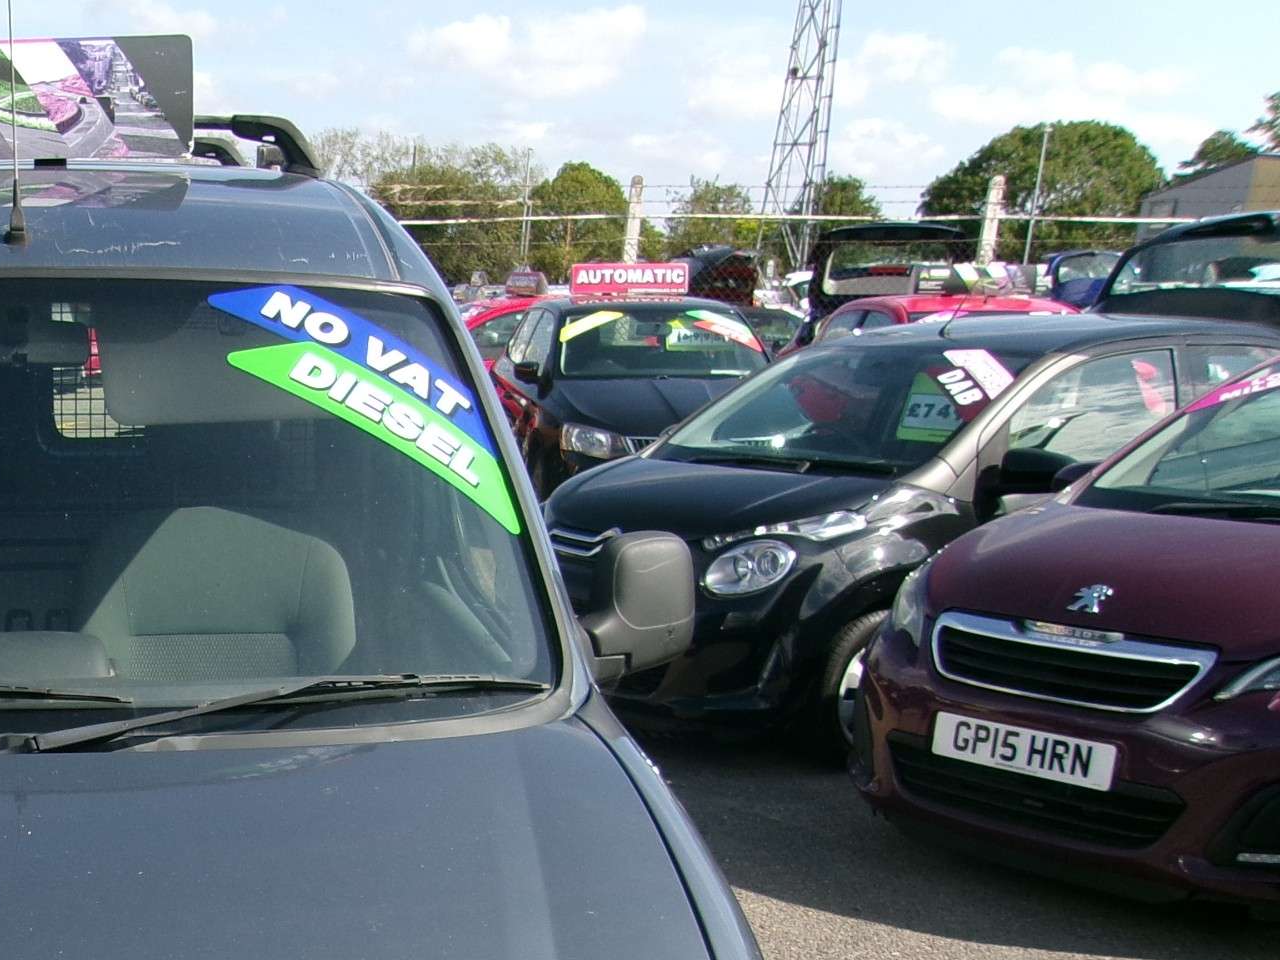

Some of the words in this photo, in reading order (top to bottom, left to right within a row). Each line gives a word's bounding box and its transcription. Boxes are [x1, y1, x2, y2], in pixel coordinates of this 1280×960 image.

[576, 268, 685, 284] AUTOMATIC
[261, 291, 350, 345] NO
[366, 335, 471, 416] VAT
[908, 402, 956, 418] £74
[936, 368, 984, 406] DAB
[288, 351, 480, 488] DIESEL
[953, 720, 1020, 762] GP15
[1026, 735, 1094, 778] HRN
